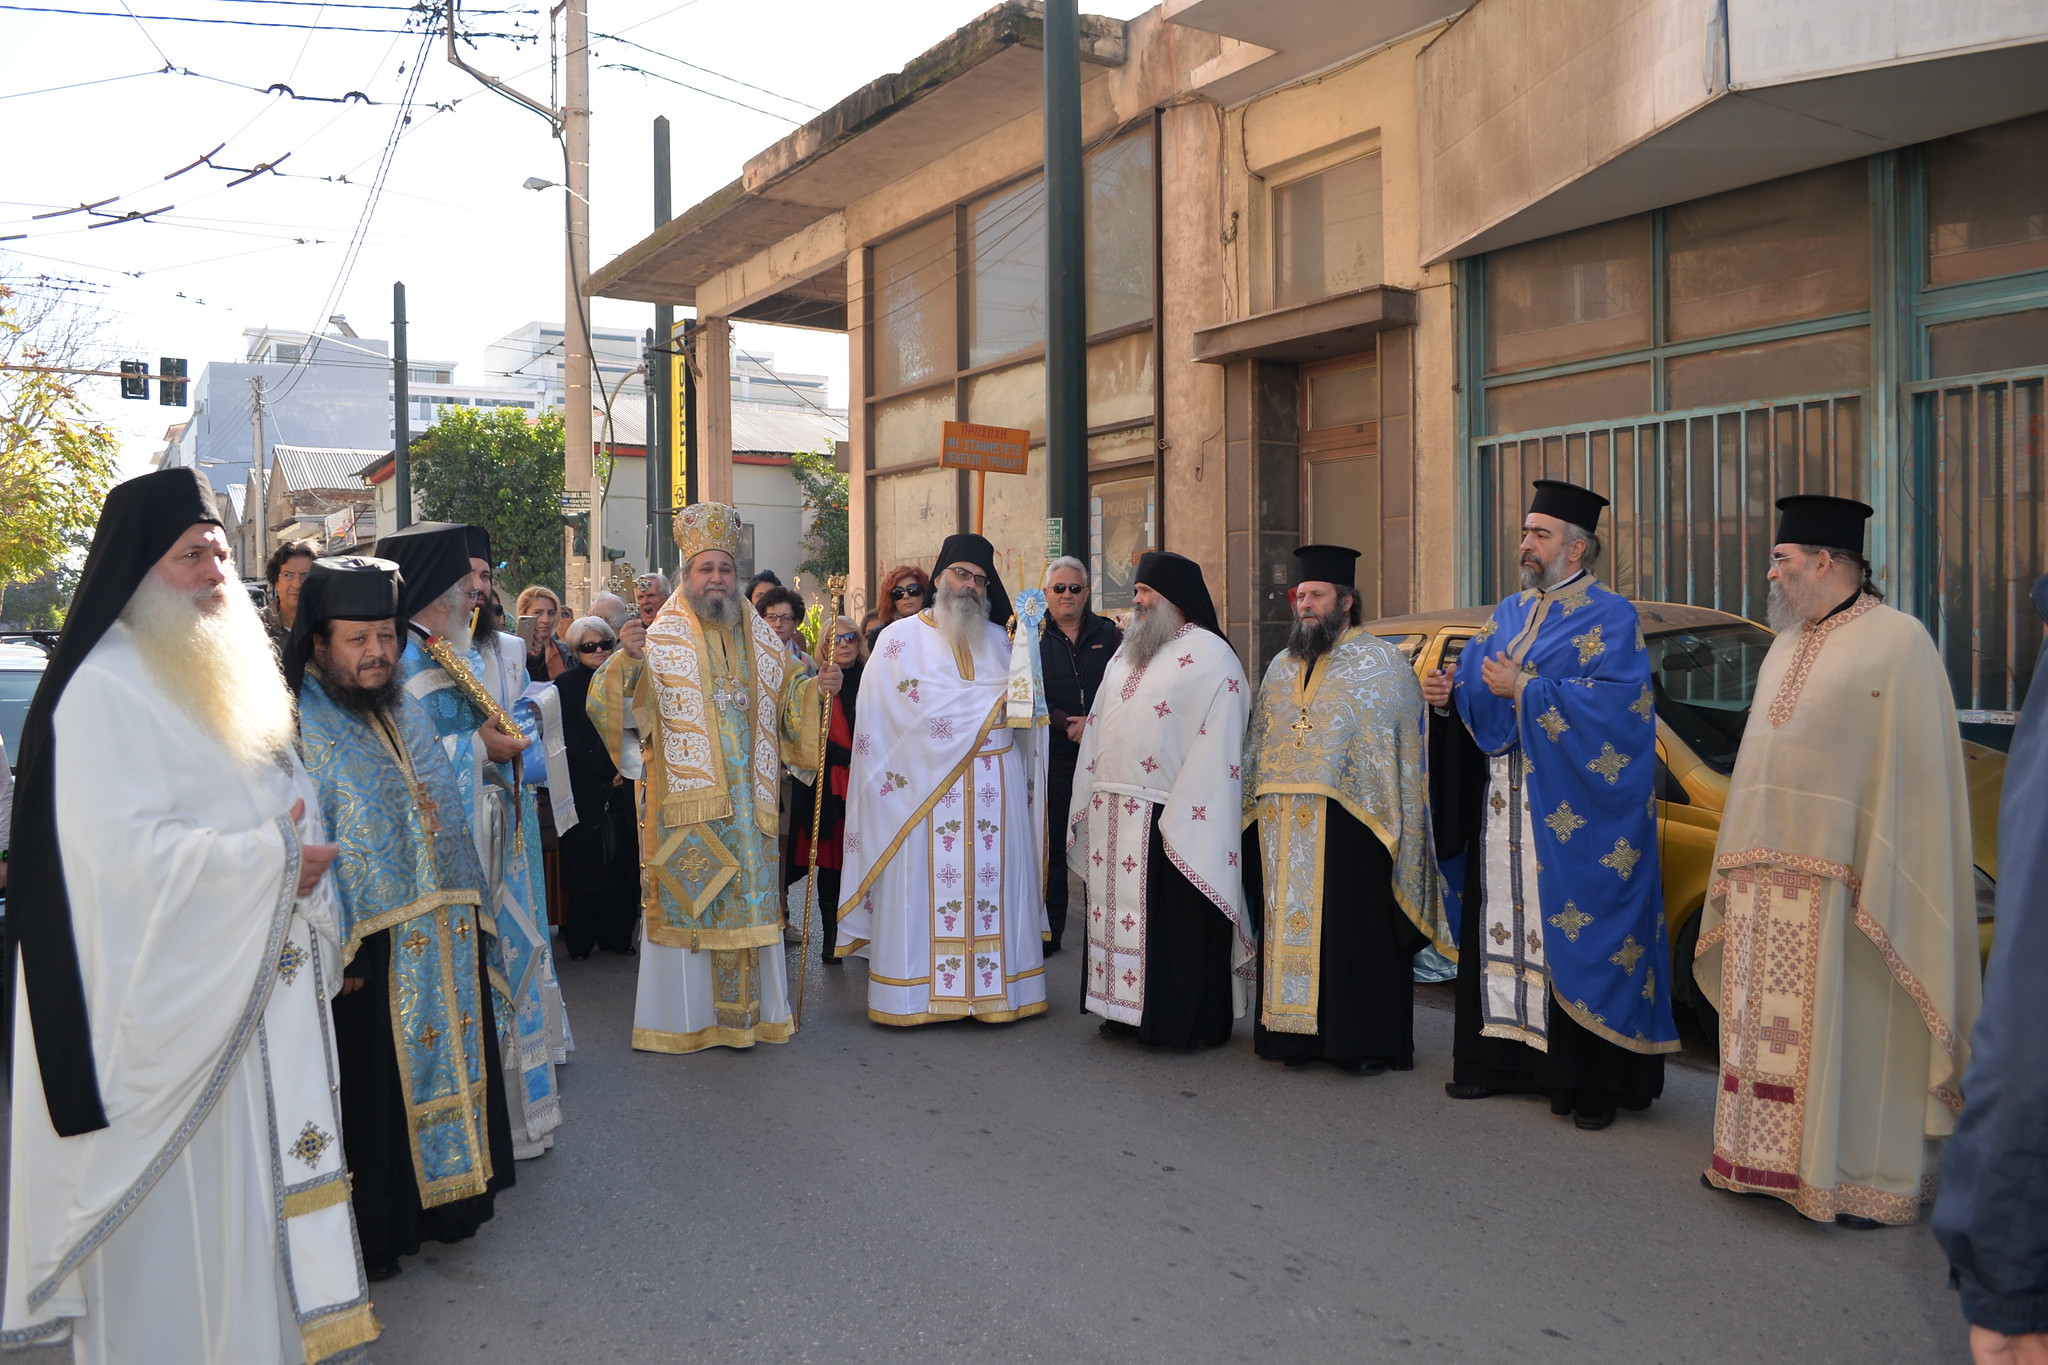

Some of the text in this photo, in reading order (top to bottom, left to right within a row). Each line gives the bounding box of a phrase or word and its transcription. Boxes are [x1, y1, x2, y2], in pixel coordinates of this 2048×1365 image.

[961, 424, 1008, 440] ΠΡΟΣΟΧΗ
[945, 437, 1023, 456] ΜΗ ΣΤΑΘΜΕΥΕΤΕ
[1103, 498, 1145, 517] POWER
